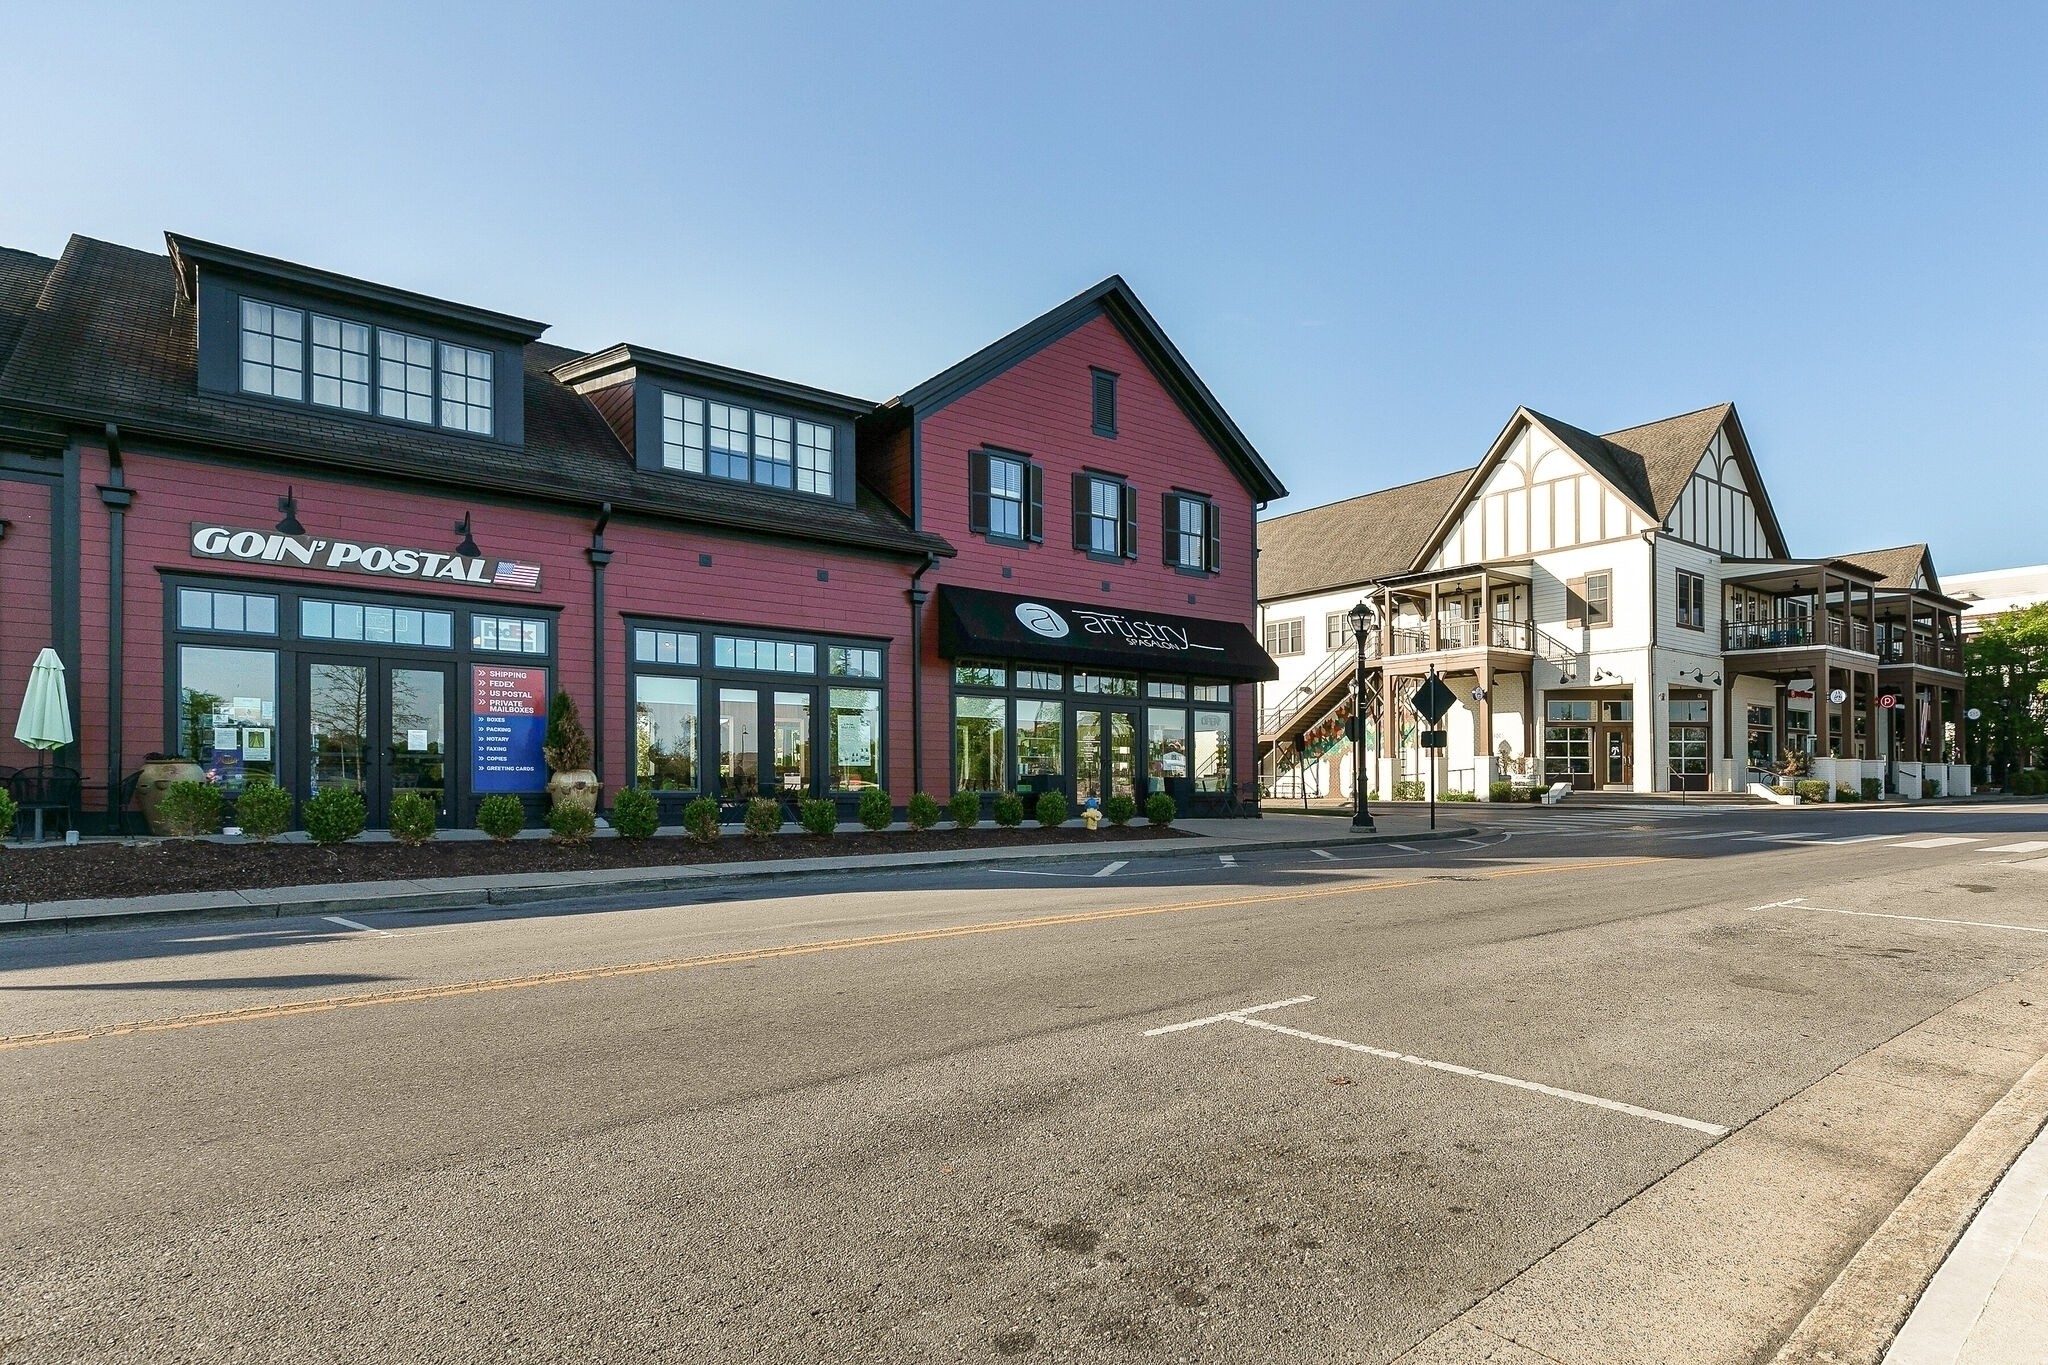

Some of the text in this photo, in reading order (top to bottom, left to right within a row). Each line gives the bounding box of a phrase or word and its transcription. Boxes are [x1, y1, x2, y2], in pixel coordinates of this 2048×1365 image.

[193, 527, 491, 584] GOIN' POSTAL
[1080, 615, 1188, 650] artistry
[489, 670, 527, 679] SHIPPING
[489, 680, 515, 688] FEDEX
[502, 690, 533, 699] POSTAL
[489, 699, 523, 707] PRIVATE
[489, 706, 535, 714] MAILBOXES
